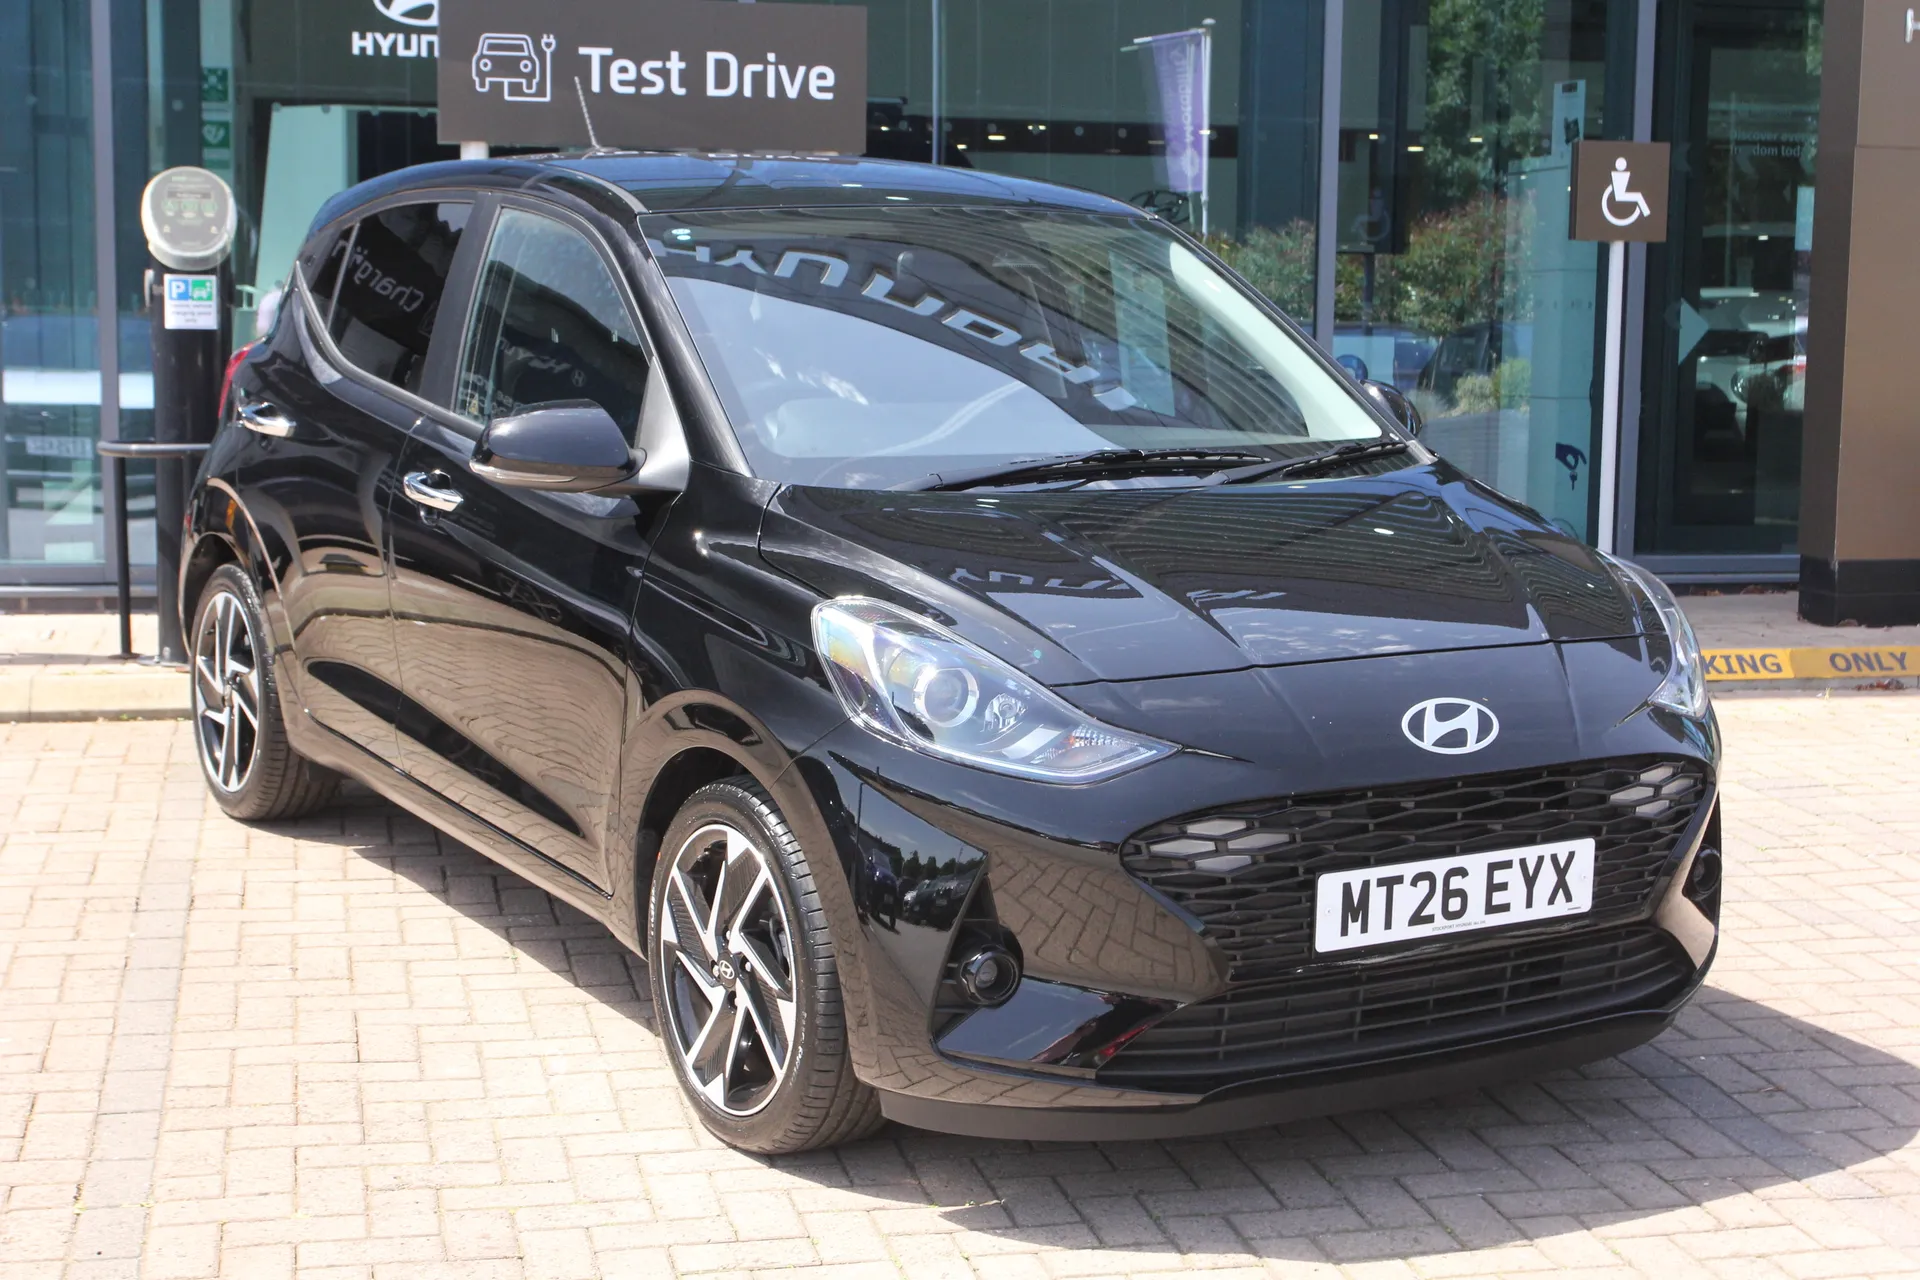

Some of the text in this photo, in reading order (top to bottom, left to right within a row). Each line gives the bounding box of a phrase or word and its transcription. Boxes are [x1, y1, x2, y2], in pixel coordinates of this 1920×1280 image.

[578, 46, 836, 100] Test Drive
[1829, 651, 1908, 673] ONLY
[1340, 850, 1576, 937] MT26 EYX
